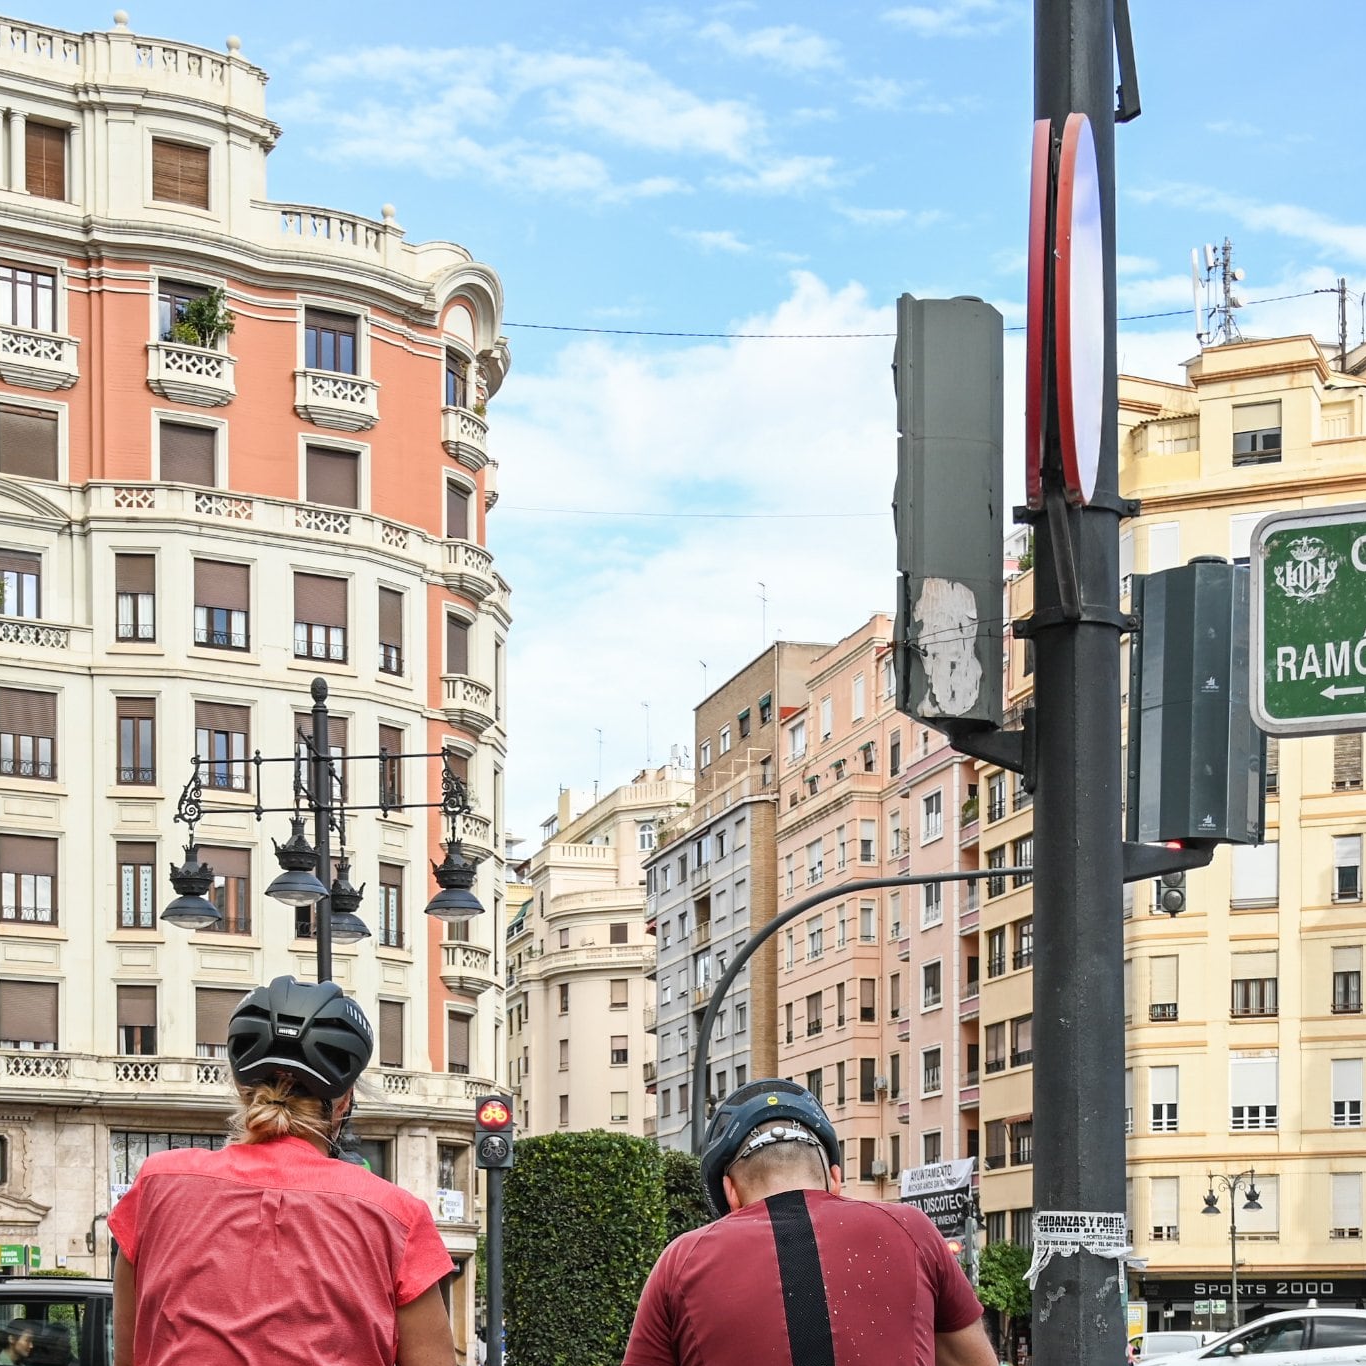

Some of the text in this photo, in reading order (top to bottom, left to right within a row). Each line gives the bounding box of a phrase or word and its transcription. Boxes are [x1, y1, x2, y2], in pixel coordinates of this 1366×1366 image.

[1088, 1216, 1095, 1227] Y
[1194, 1282, 1334, 1295] SPORTS 2000
